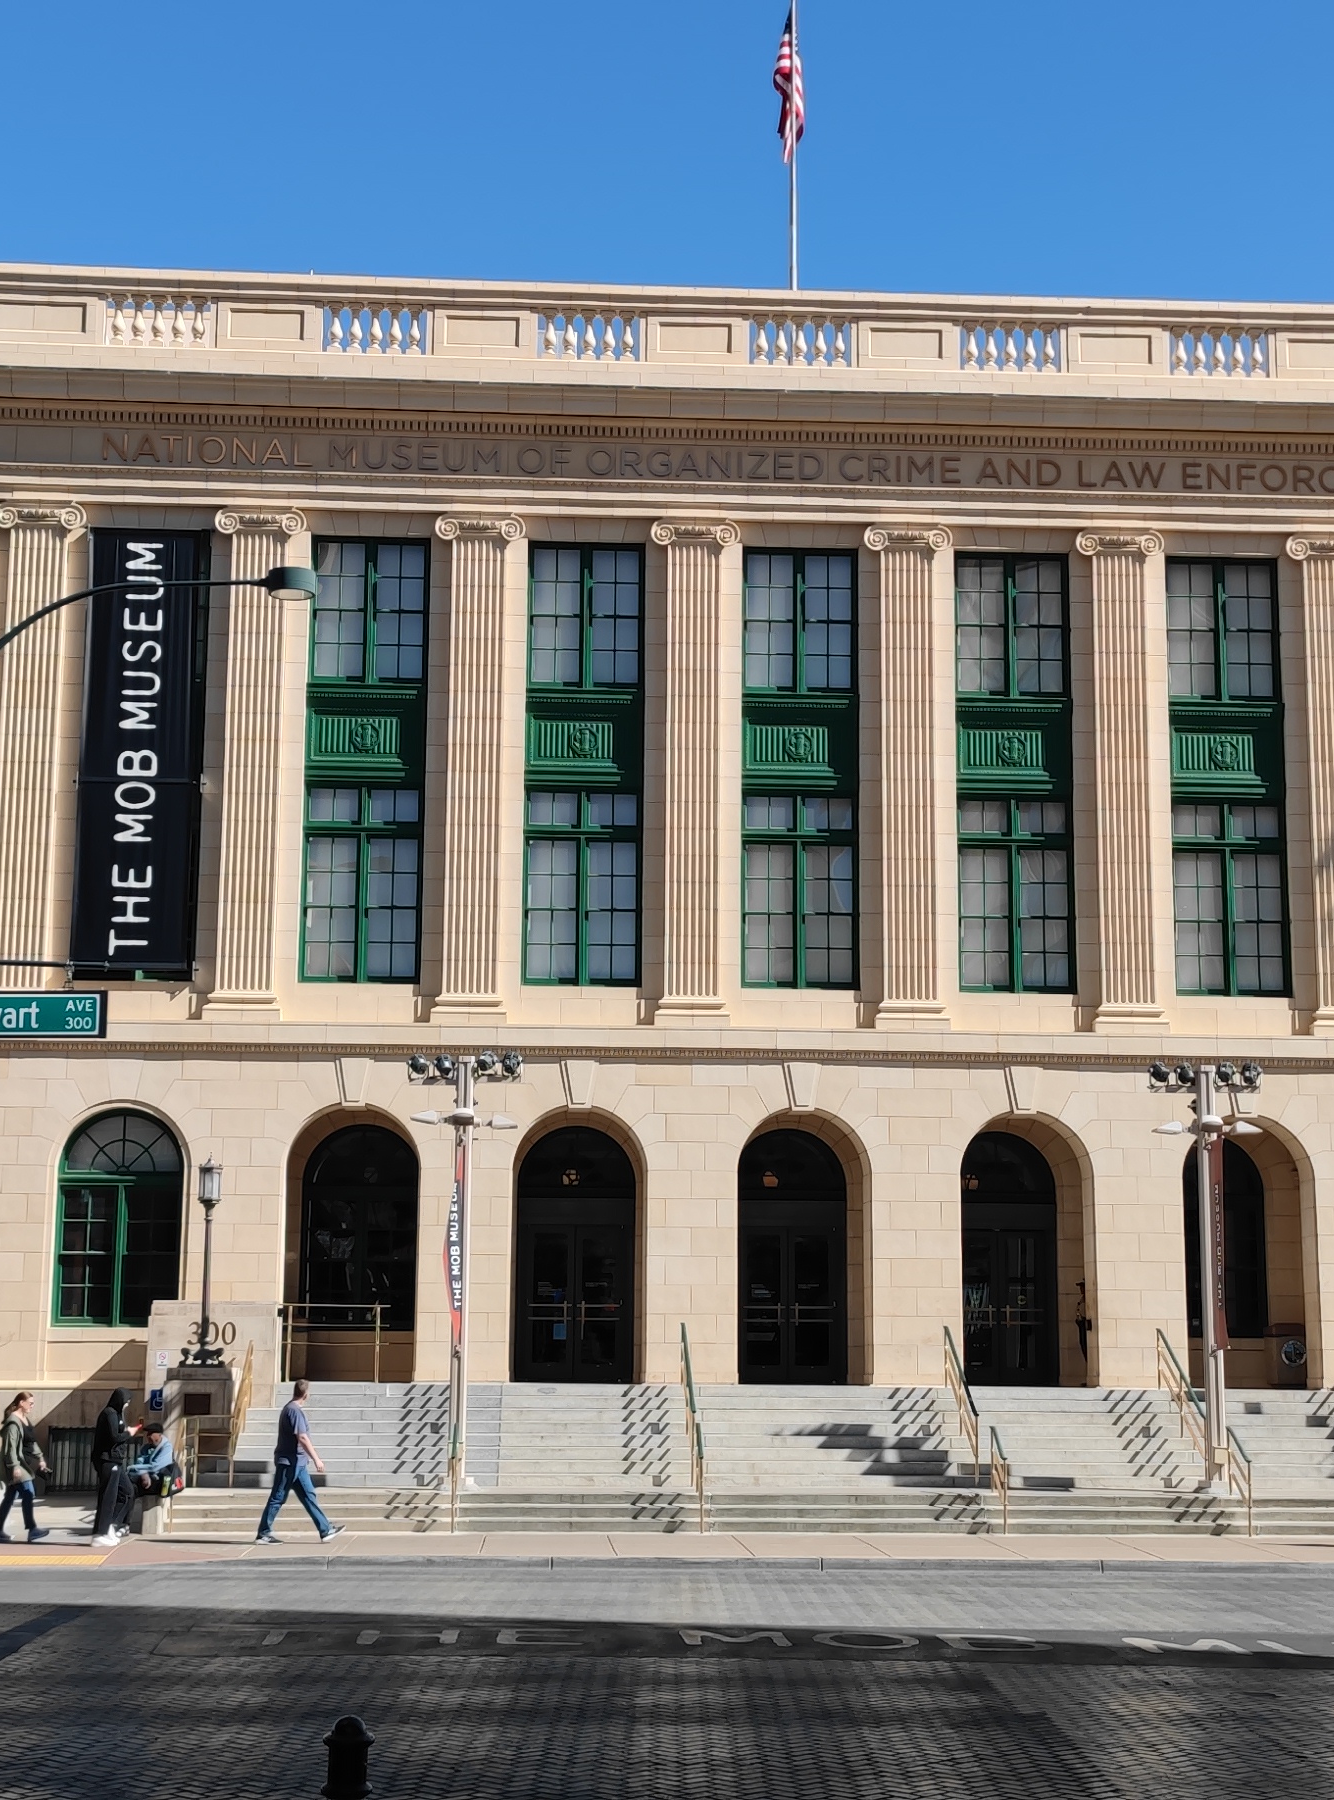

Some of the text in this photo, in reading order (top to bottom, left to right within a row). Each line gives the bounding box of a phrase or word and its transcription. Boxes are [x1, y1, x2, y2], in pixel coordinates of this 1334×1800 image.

[101, 431, 313, 467] NATIONAL
[328, 436, 503, 473] MUSEUM
[516, 446, 572, 475] OF
[586, 448, 825, 482] ORGANIZED
[838, 452, 962, 485] CRIME
[976, 457, 1063, 488] AND
[1076, 459, 1168, 490] LAW
[107, 541, 165, 956] THE MOB MUSEUM
[65, 999, 94, 1013] AVE
[64, 1016, 93, 1030] 300
[451, 1245, 461, 1278] MOB
[453, 1279, 462, 1309] THE
[186, 1321, 237, 1346] 300
[259, 1629, 585, 1646] THE
[677, 1629, 1054, 1653] MOB
